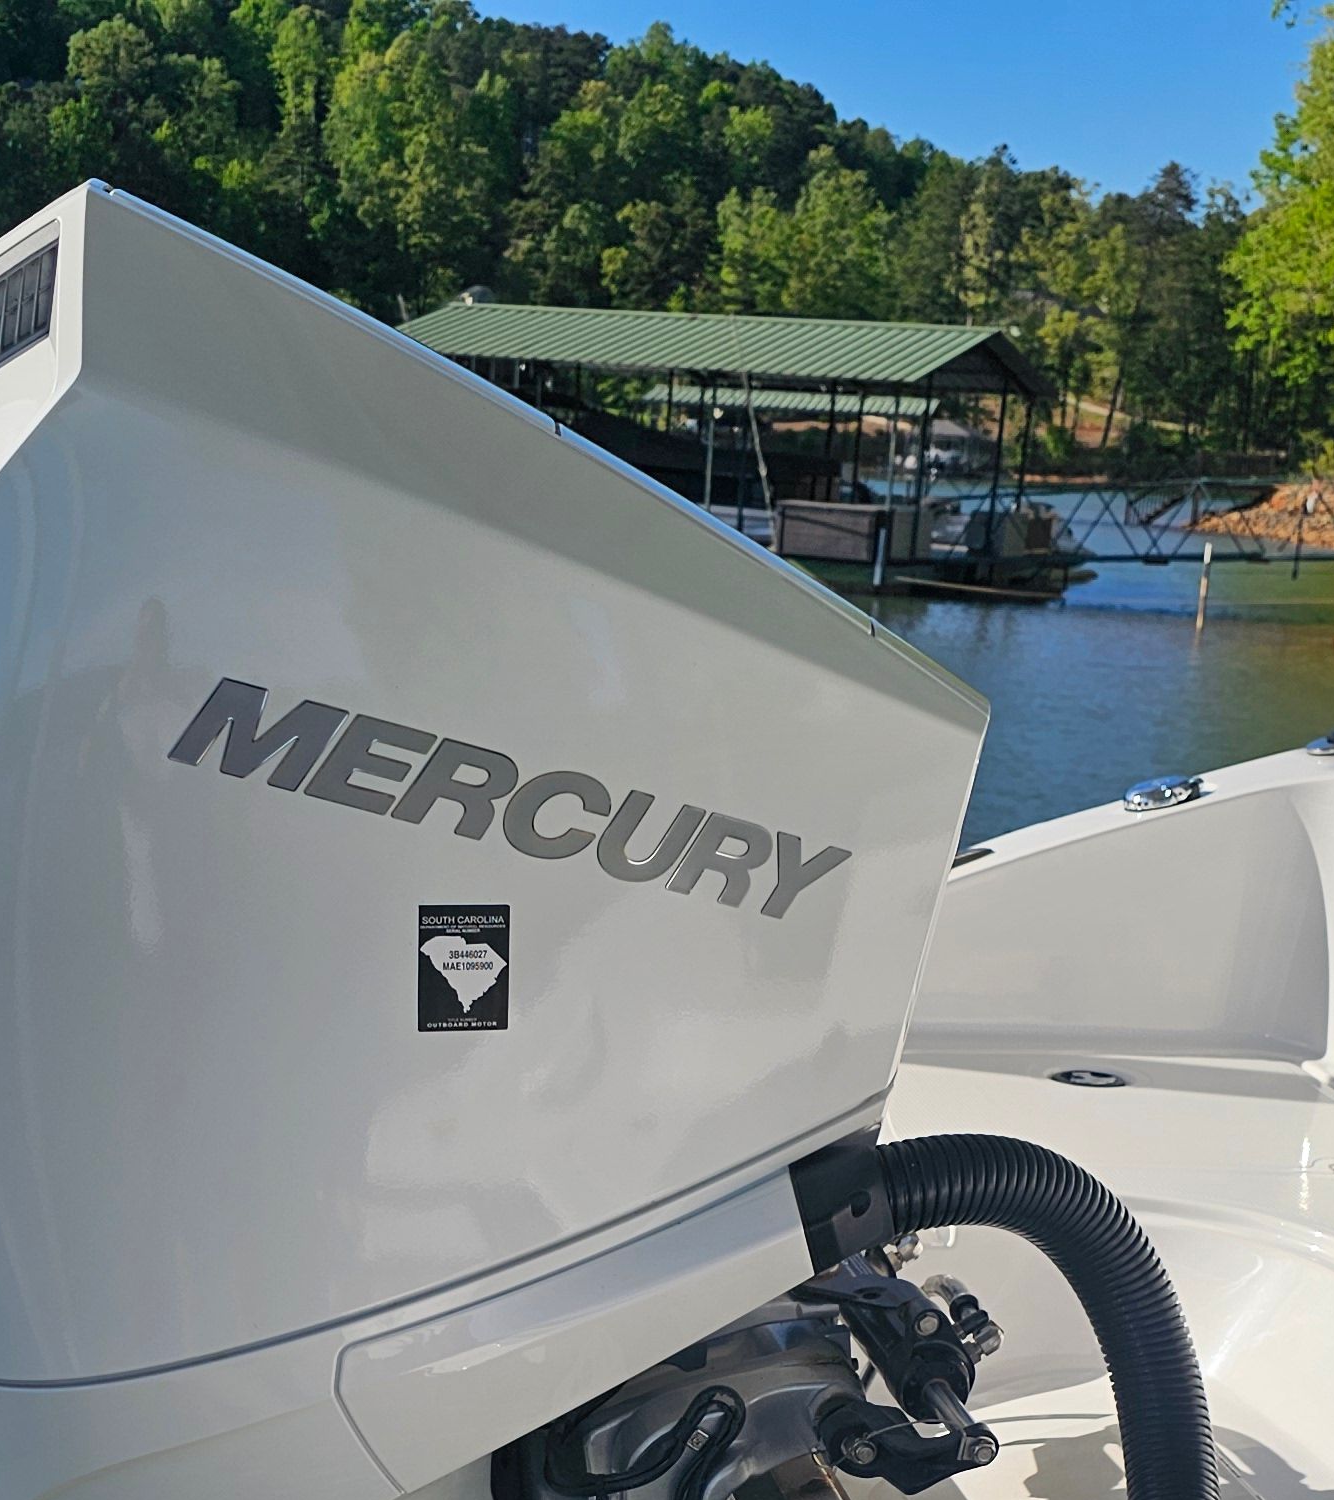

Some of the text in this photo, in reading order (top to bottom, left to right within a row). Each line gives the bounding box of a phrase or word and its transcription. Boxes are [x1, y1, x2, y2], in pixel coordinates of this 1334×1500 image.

[167, 676, 853, 920] MERCURY
[421, 915, 505, 925] SOUTH CAROLINA
